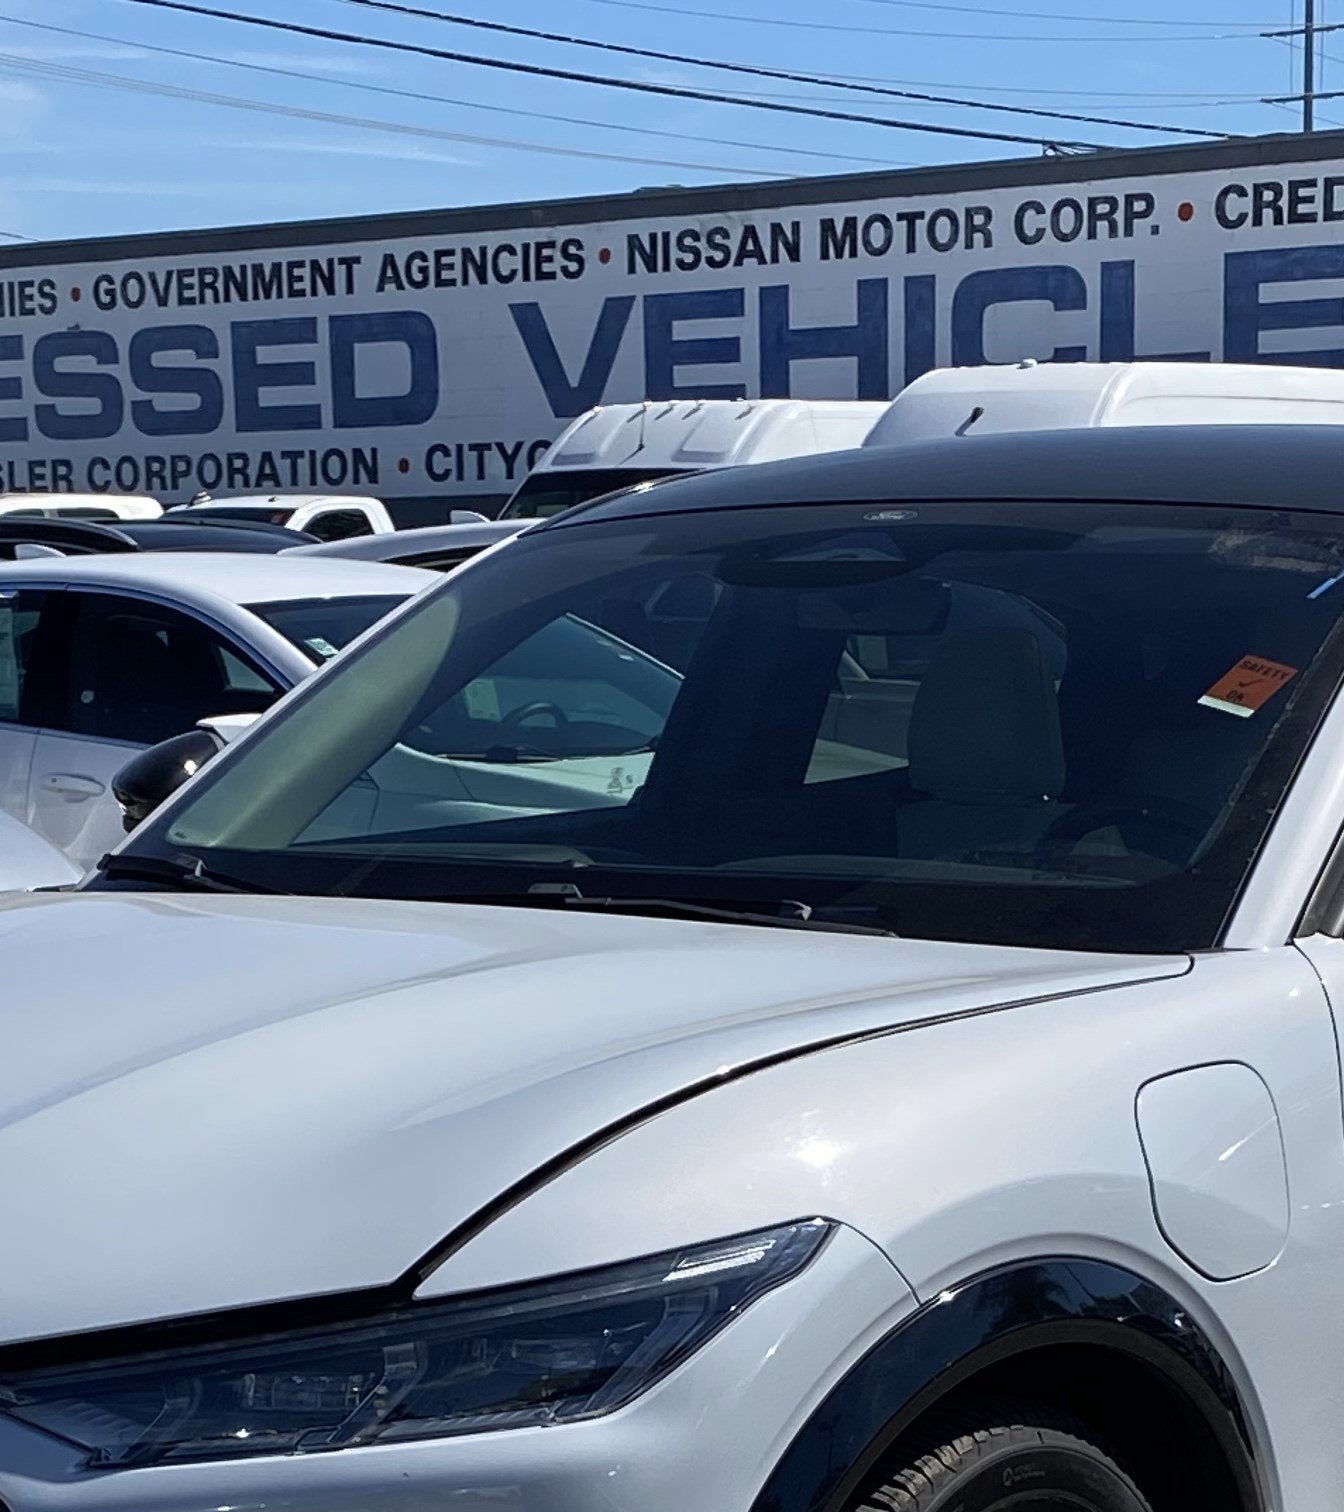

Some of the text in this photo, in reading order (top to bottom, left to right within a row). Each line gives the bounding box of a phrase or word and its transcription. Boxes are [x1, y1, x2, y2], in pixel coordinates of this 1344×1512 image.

[92, 255, 361, 312] GOVERNMENT
[375, 237, 586, 293] AGENCIES
[626, 219, 802, 275] NISSAN
[819, 204, 994, 262] MOTOR
[1013, 191, 1161, 246] CORP.
[87, 447, 379, 493] CORPORATION
